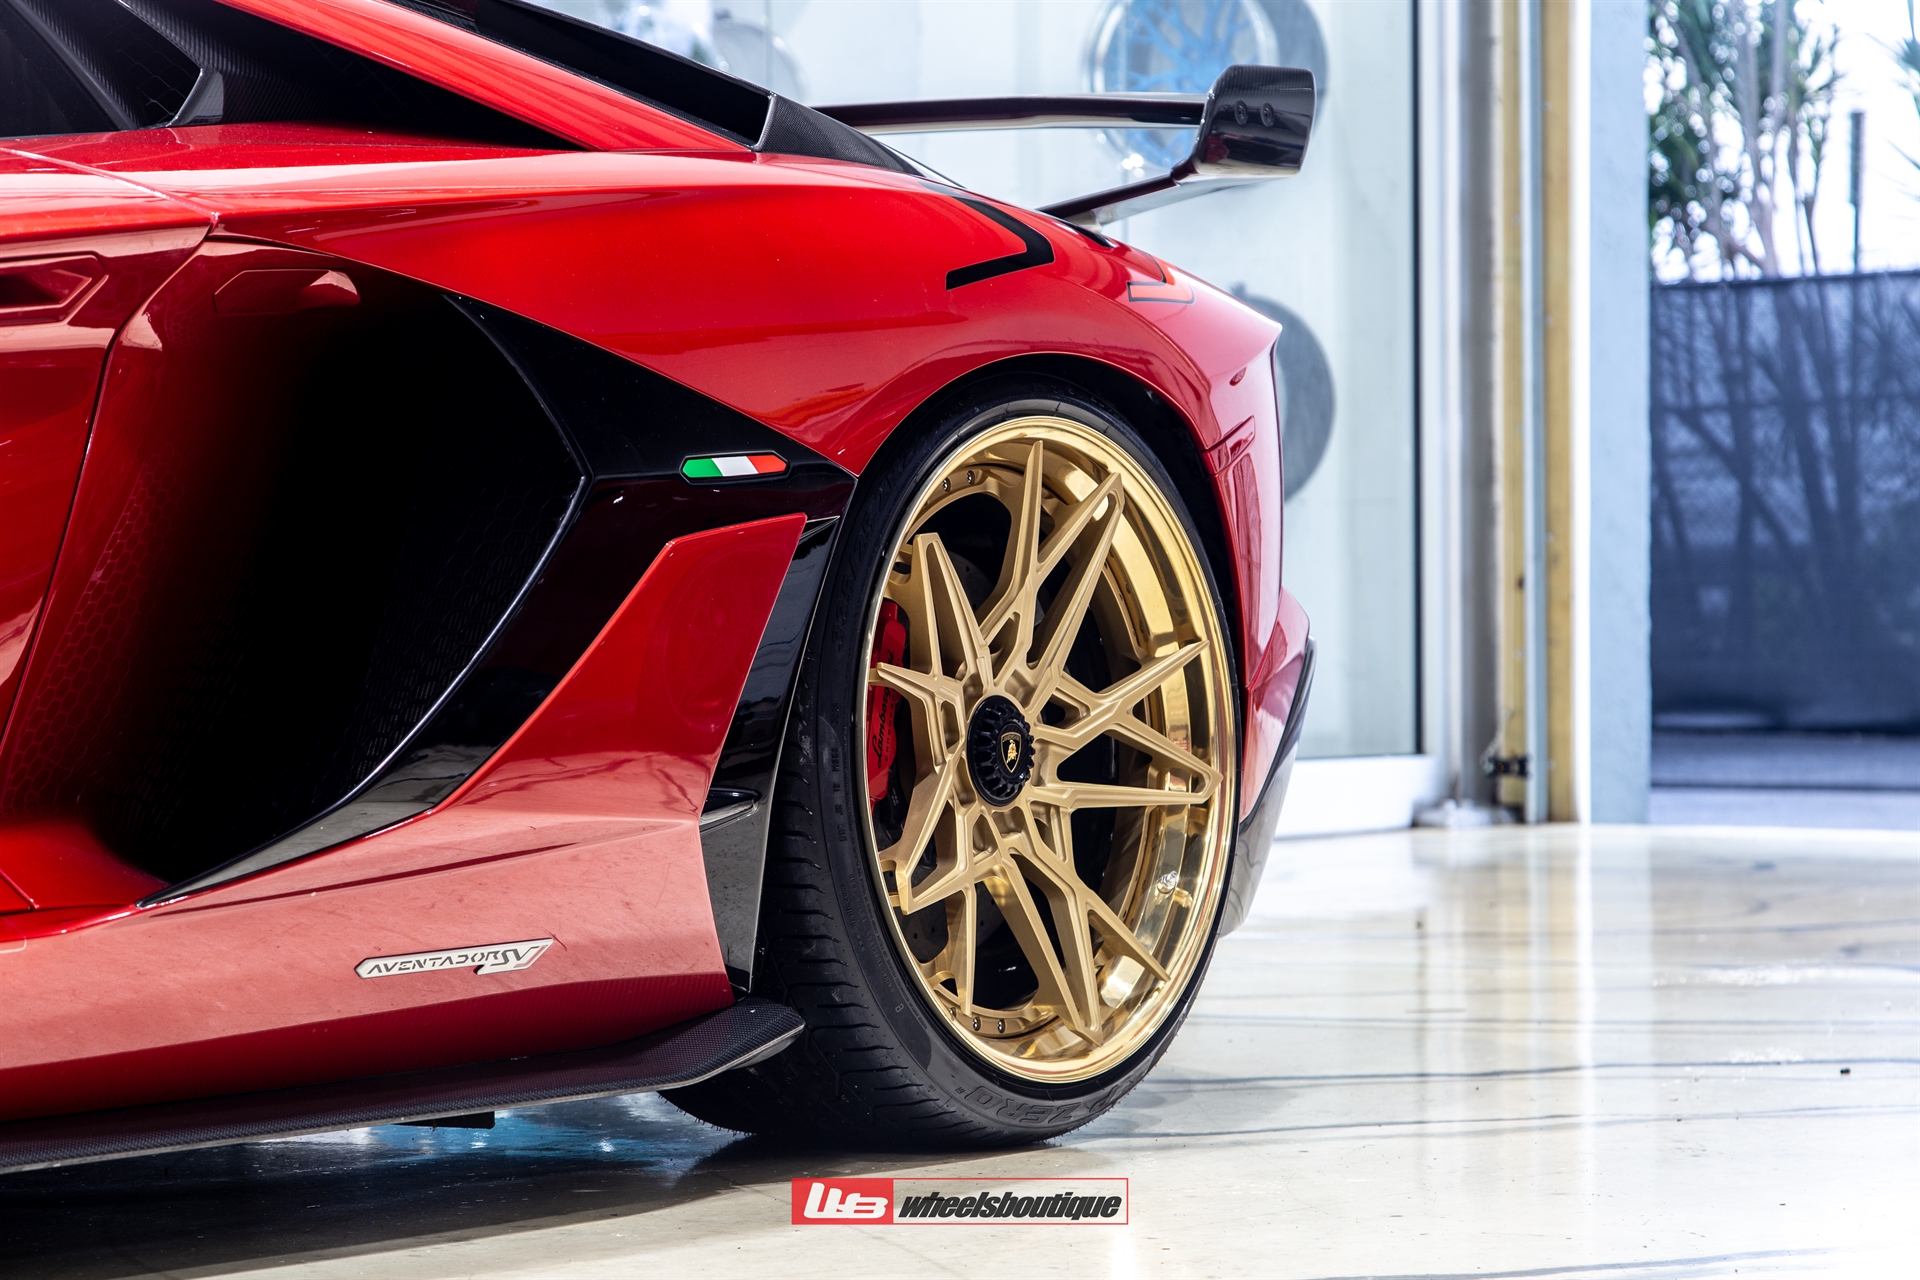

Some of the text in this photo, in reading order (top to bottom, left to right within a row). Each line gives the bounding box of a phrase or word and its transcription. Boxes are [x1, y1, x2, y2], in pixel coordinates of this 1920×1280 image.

[872, 649, 895, 769] Lamborgni
[367, 950, 500, 975] AVENTADOR
[965, 1086, 1081, 1124] ZERO
